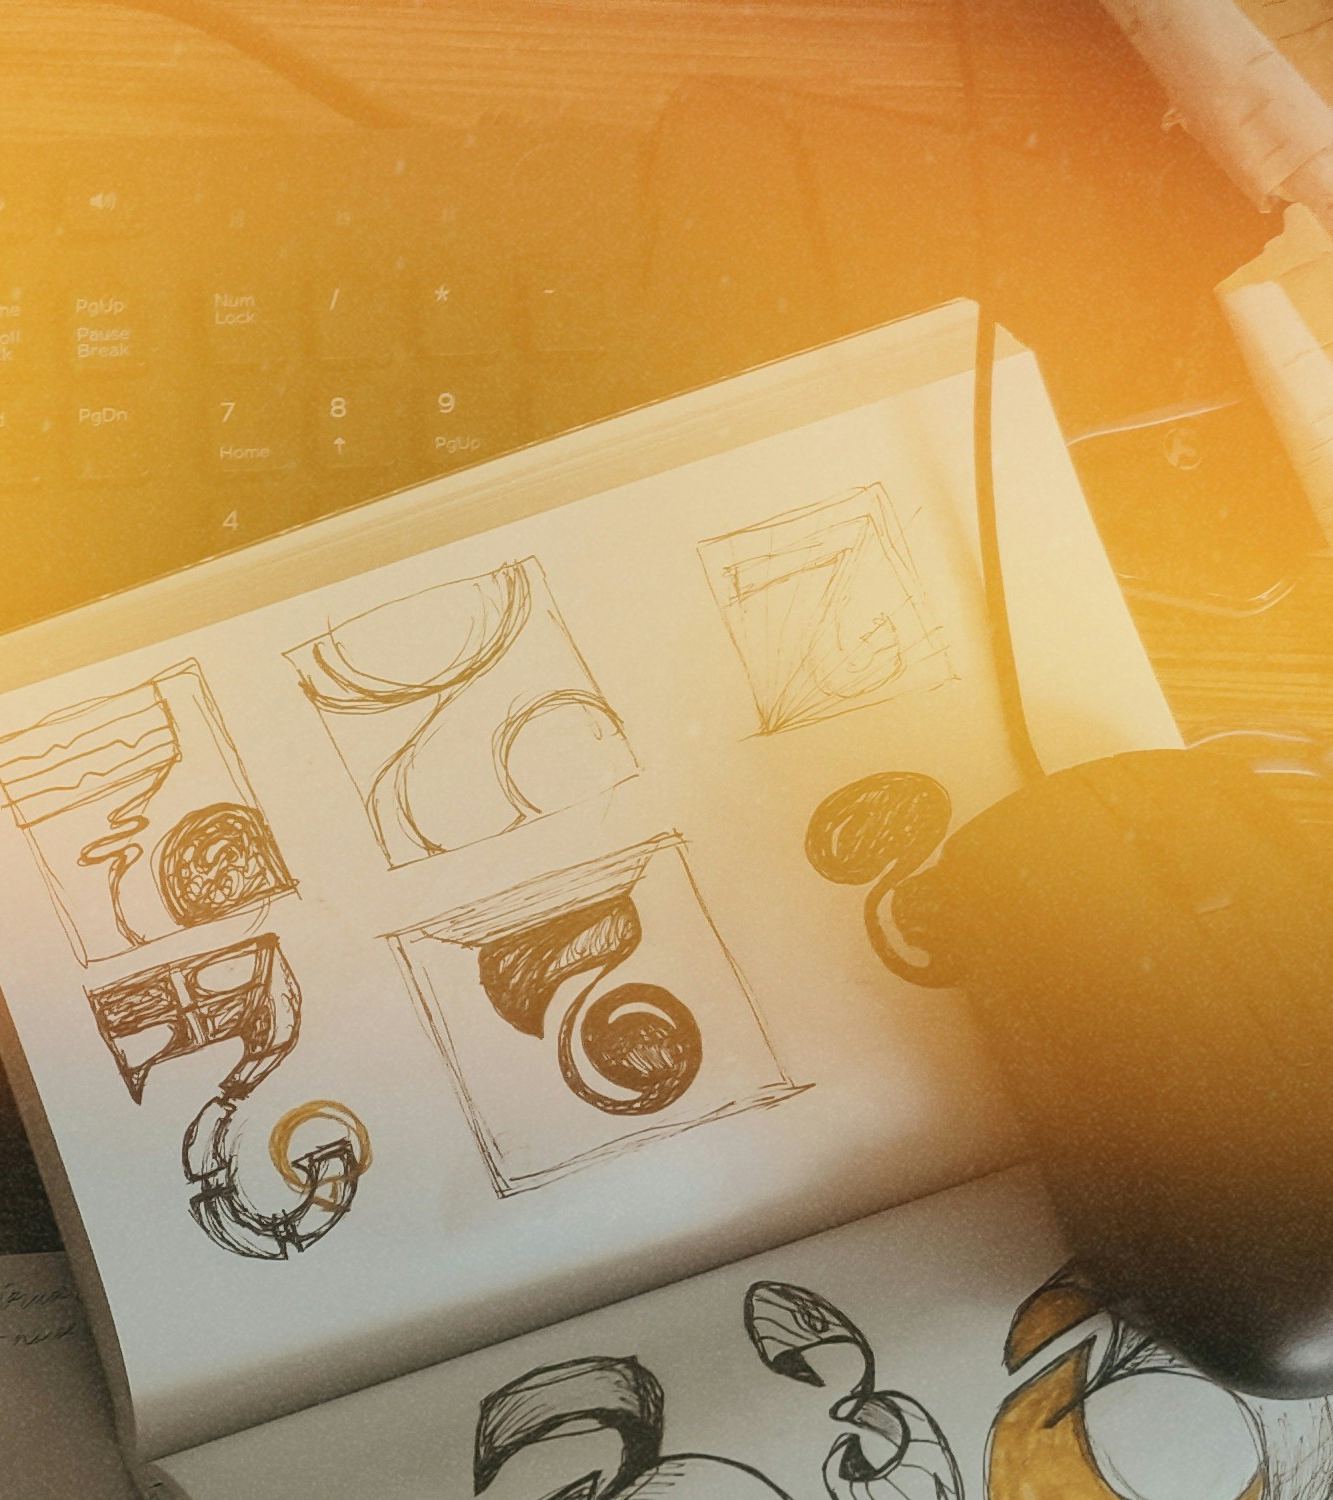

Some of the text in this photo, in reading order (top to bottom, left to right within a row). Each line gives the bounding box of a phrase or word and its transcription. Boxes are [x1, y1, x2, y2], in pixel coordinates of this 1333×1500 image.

[75, 297, 125, 316] PgUp
[214, 293, 256, 309] Num
[214, 309, 258, 325] Lock
[76, 327, 130, 342] Pause
[76, 342, 130, 359] Break
[329, 397, 347, 419] 8
[437, 392, 455, 414] 9
[78, 407, 128, 425] PgDn
[221, 402, 235, 424] 7
[219, 445, 270, 460] Home
[434, 435, 481, 453] PgUp
[222, 510, 238, 532] 4
